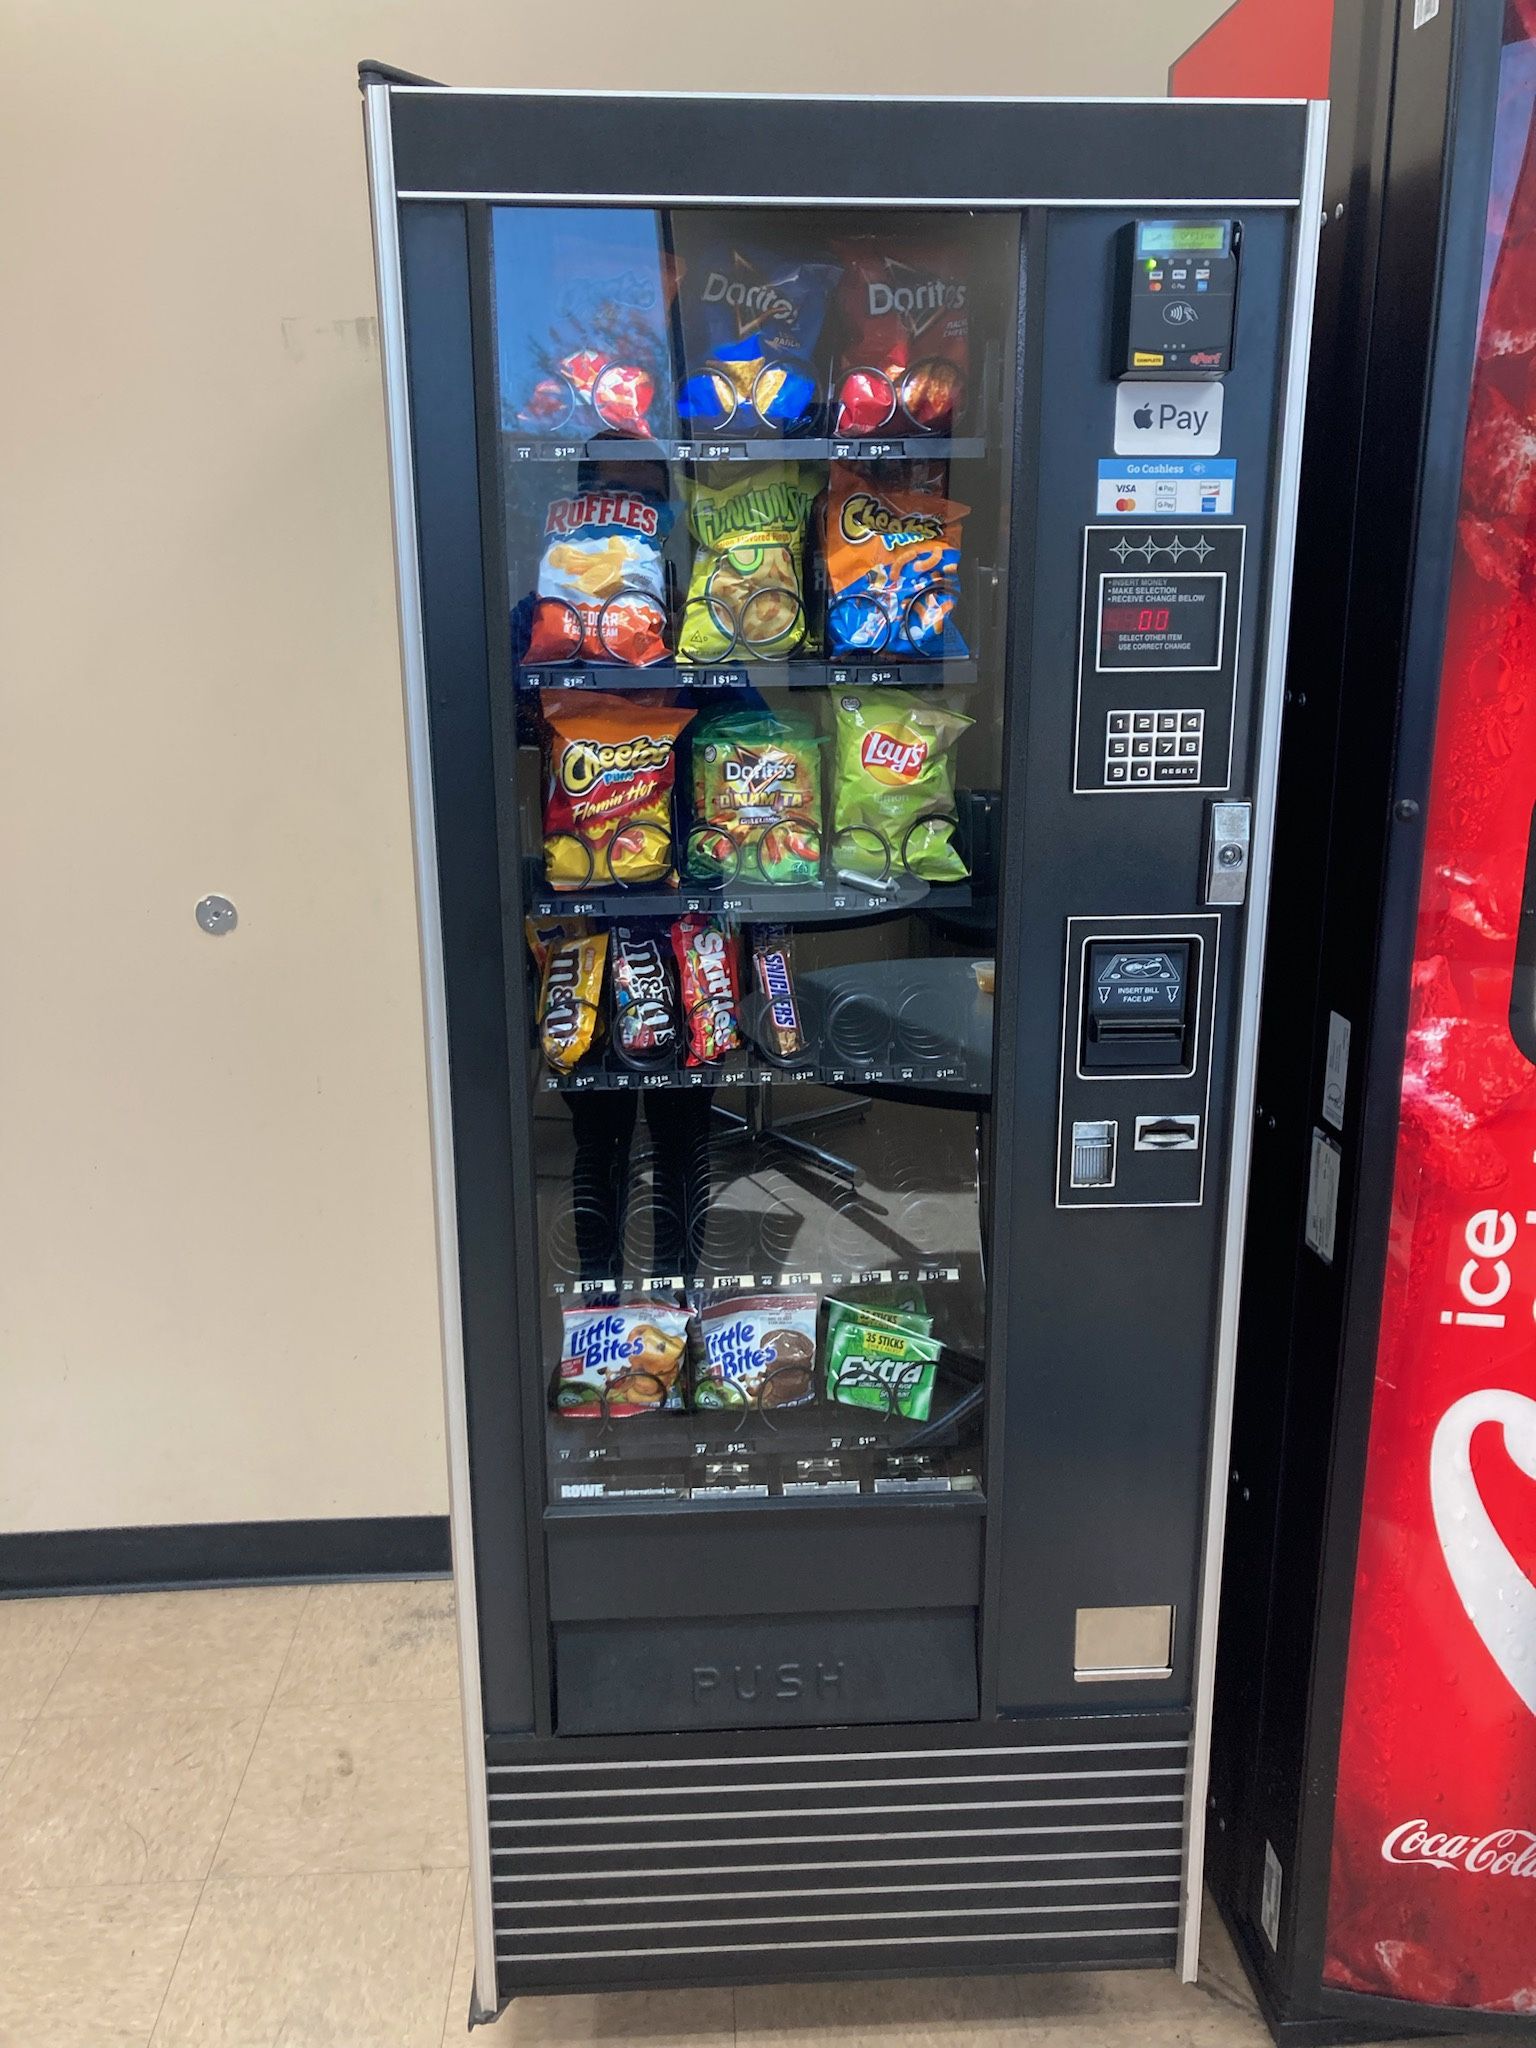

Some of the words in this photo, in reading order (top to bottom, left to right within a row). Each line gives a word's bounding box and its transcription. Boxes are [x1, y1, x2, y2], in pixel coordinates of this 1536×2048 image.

[869, 281, 966, 315] Doritos
[1159, 404, 1208, 436] Pay
[1127, 464, 1139, 473] Go
[1142, 464, 1184, 474] Cashless
[1116, 484, 1136, 493] VISA
[545, 498, 658, 535] RUFFLES
[694, 483, 799, 546] FUNYUNS
[841, 494, 941, 541] Cheetos
[1112, 579, 1139, 587] INSERT
[1112, 587, 1134, 595] MAKE
[1136, 587, 1177, 595] SELECTION
[1112, 595, 1143, 603] RECEIVE
[1178, 594, 1205, 602] BELOW
[571, 626, 593, 636] SOR
[592, 627, 619, 637] CEAM
[529, 677, 540, 685] 12
[683, 676, 693, 684] 32
[1116, 719, 1124, 729] 1
[1139, 719, 1150, 729] 2
[1163, 719, 1174, 728] 3
[1187, 718, 1197, 728] 4
[864, 732, 926, 774] Lay's
[1114, 743, 1125, 753] 5
[1138, 743, 1149, 753] 6
[1162, 743, 1173, 753] 7
[1185, 742, 1196, 752] 8
[562, 738, 674, 794] Cheetos
[726, 760, 797, 780] Doritos
[1112, 768, 1124, 778] 9
[1137, 768, 1148, 777] 0
[626, 779, 657, 801] Hot
[688, 903, 698, 911] 33
[1441, 1208, 1517, 1328] ice
[571, 1315, 625, 1357] Little
[865, 1332, 876, 1343] 35
[878, 1334, 904, 1350] STICKS
[585, 1337, 644, 1368] Bites
[720, 1346, 778, 1378] Bites
[839, 1355, 924, 1386] Extra
[561, 1484, 604, 1498] ROWE
[691, 1661, 844, 1703] PUSH
